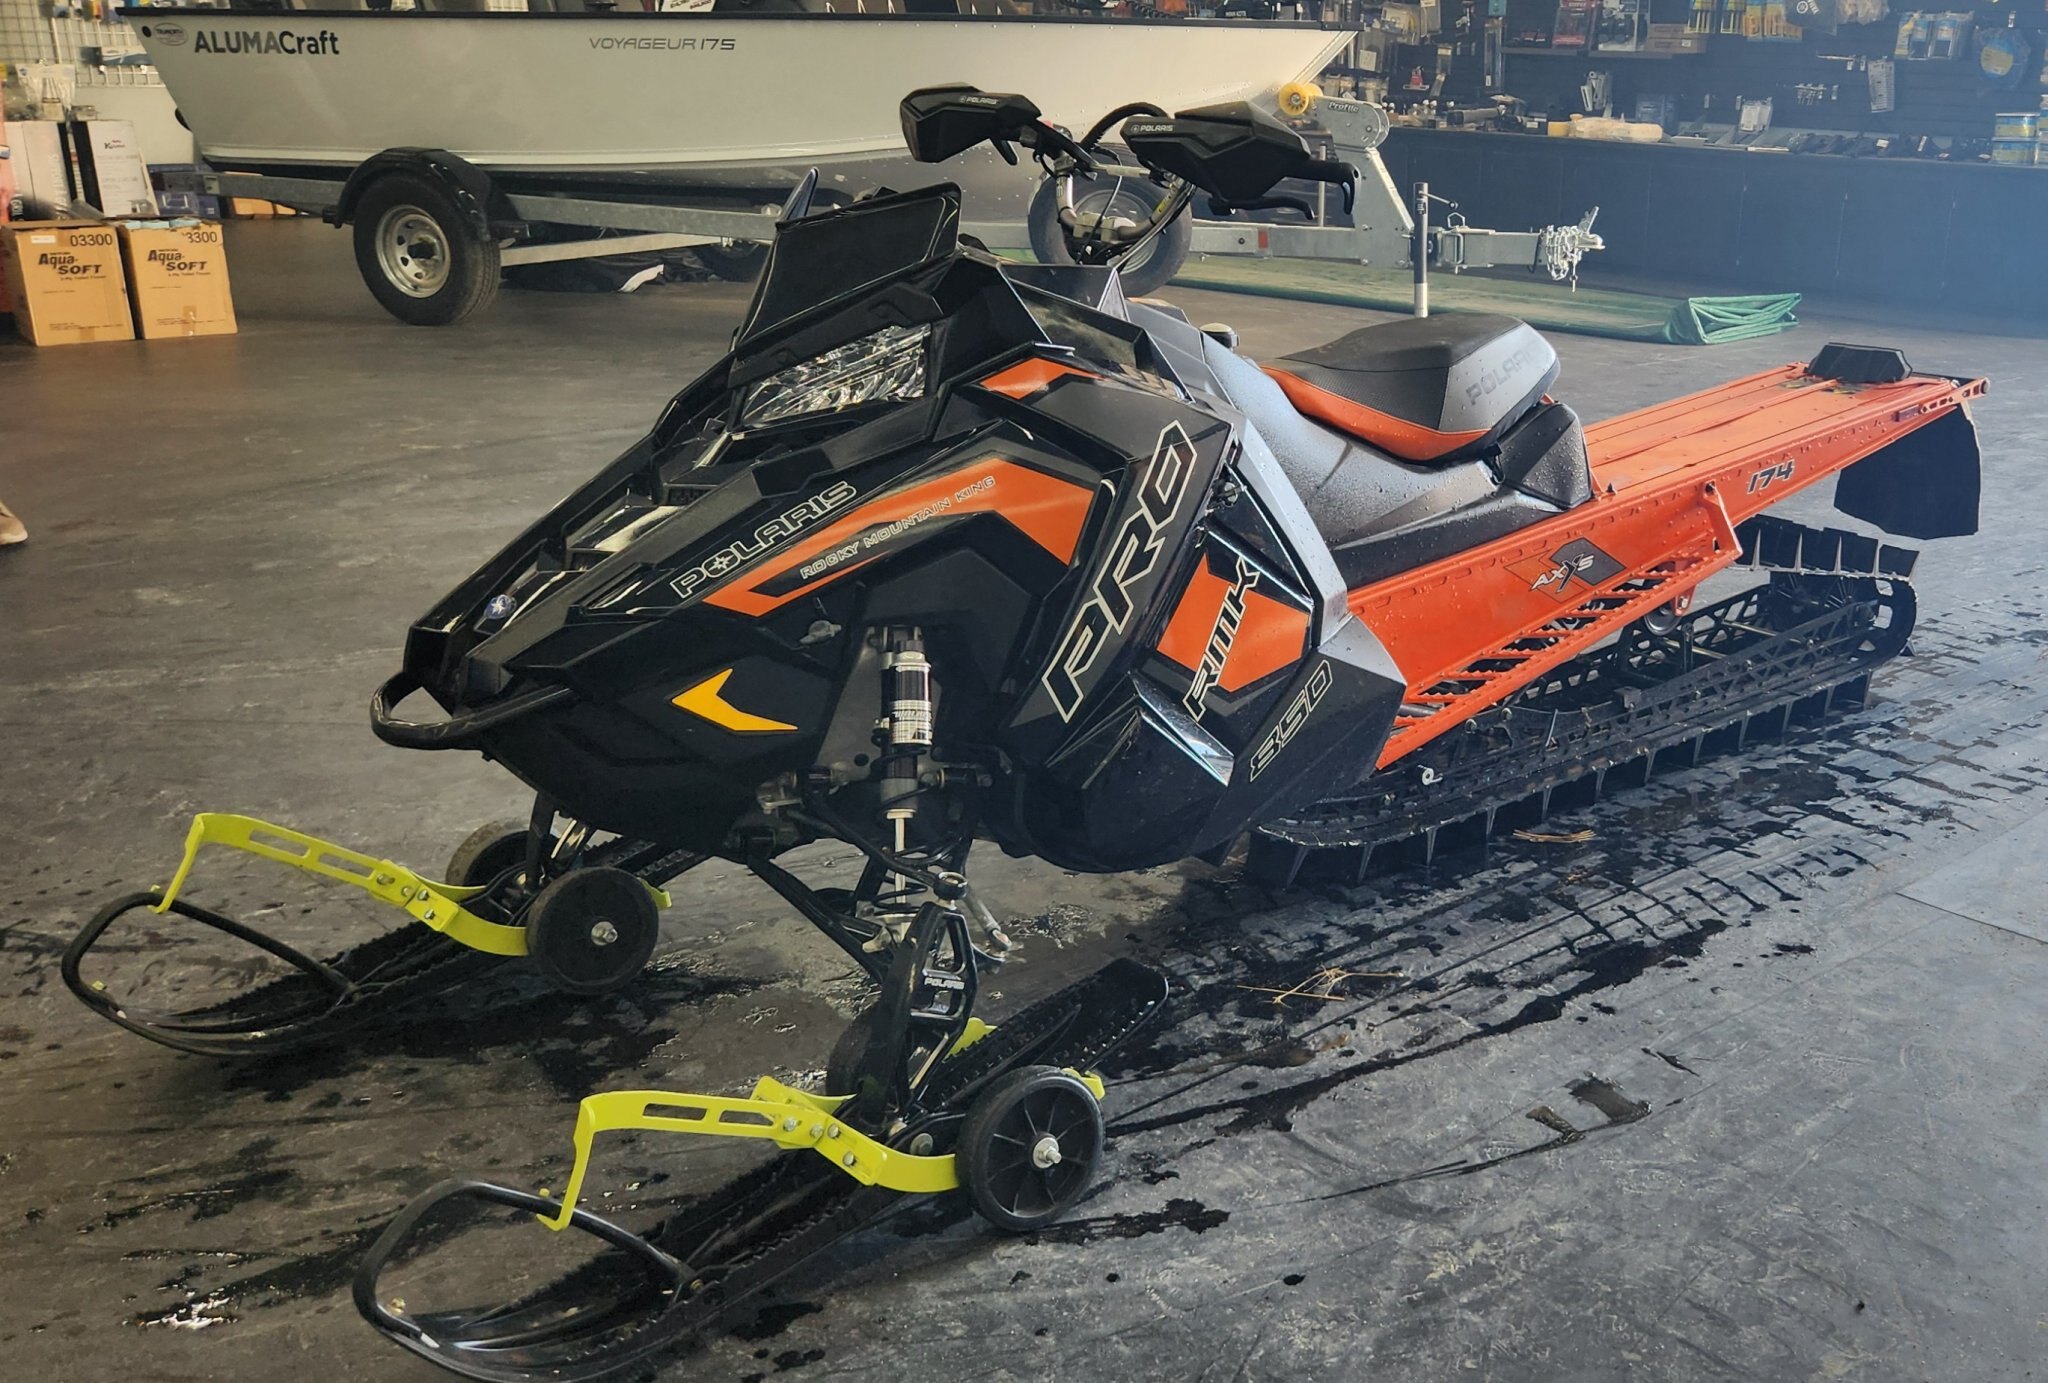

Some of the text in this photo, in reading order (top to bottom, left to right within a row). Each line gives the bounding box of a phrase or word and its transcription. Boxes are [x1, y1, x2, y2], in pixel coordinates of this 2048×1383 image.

[194, 29, 340, 55] ALUMACraft
[589, 37, 697, 50] VOYAGEUR
[966, 95, 998, 105] POLARIS
[1140, 124, 1174, 132] POLARIS
[69, 233, 113, 247] 03300
[58, 263, 102, 275] SOFT
[165, 260, 207, 271] SOFT
[1746, 459, 1795, 494] 174
[800, 475, 996, 579] ROCKY MOUNTAIN KING
[670, 481, 857, 599] POLARIS
[1042, 420, 1198, 723] PRO
[1182, 555, 1260, 722] RMK
[1249, 659, 1333, 783] 850
[923, 977, 965, 990] POLARIS
